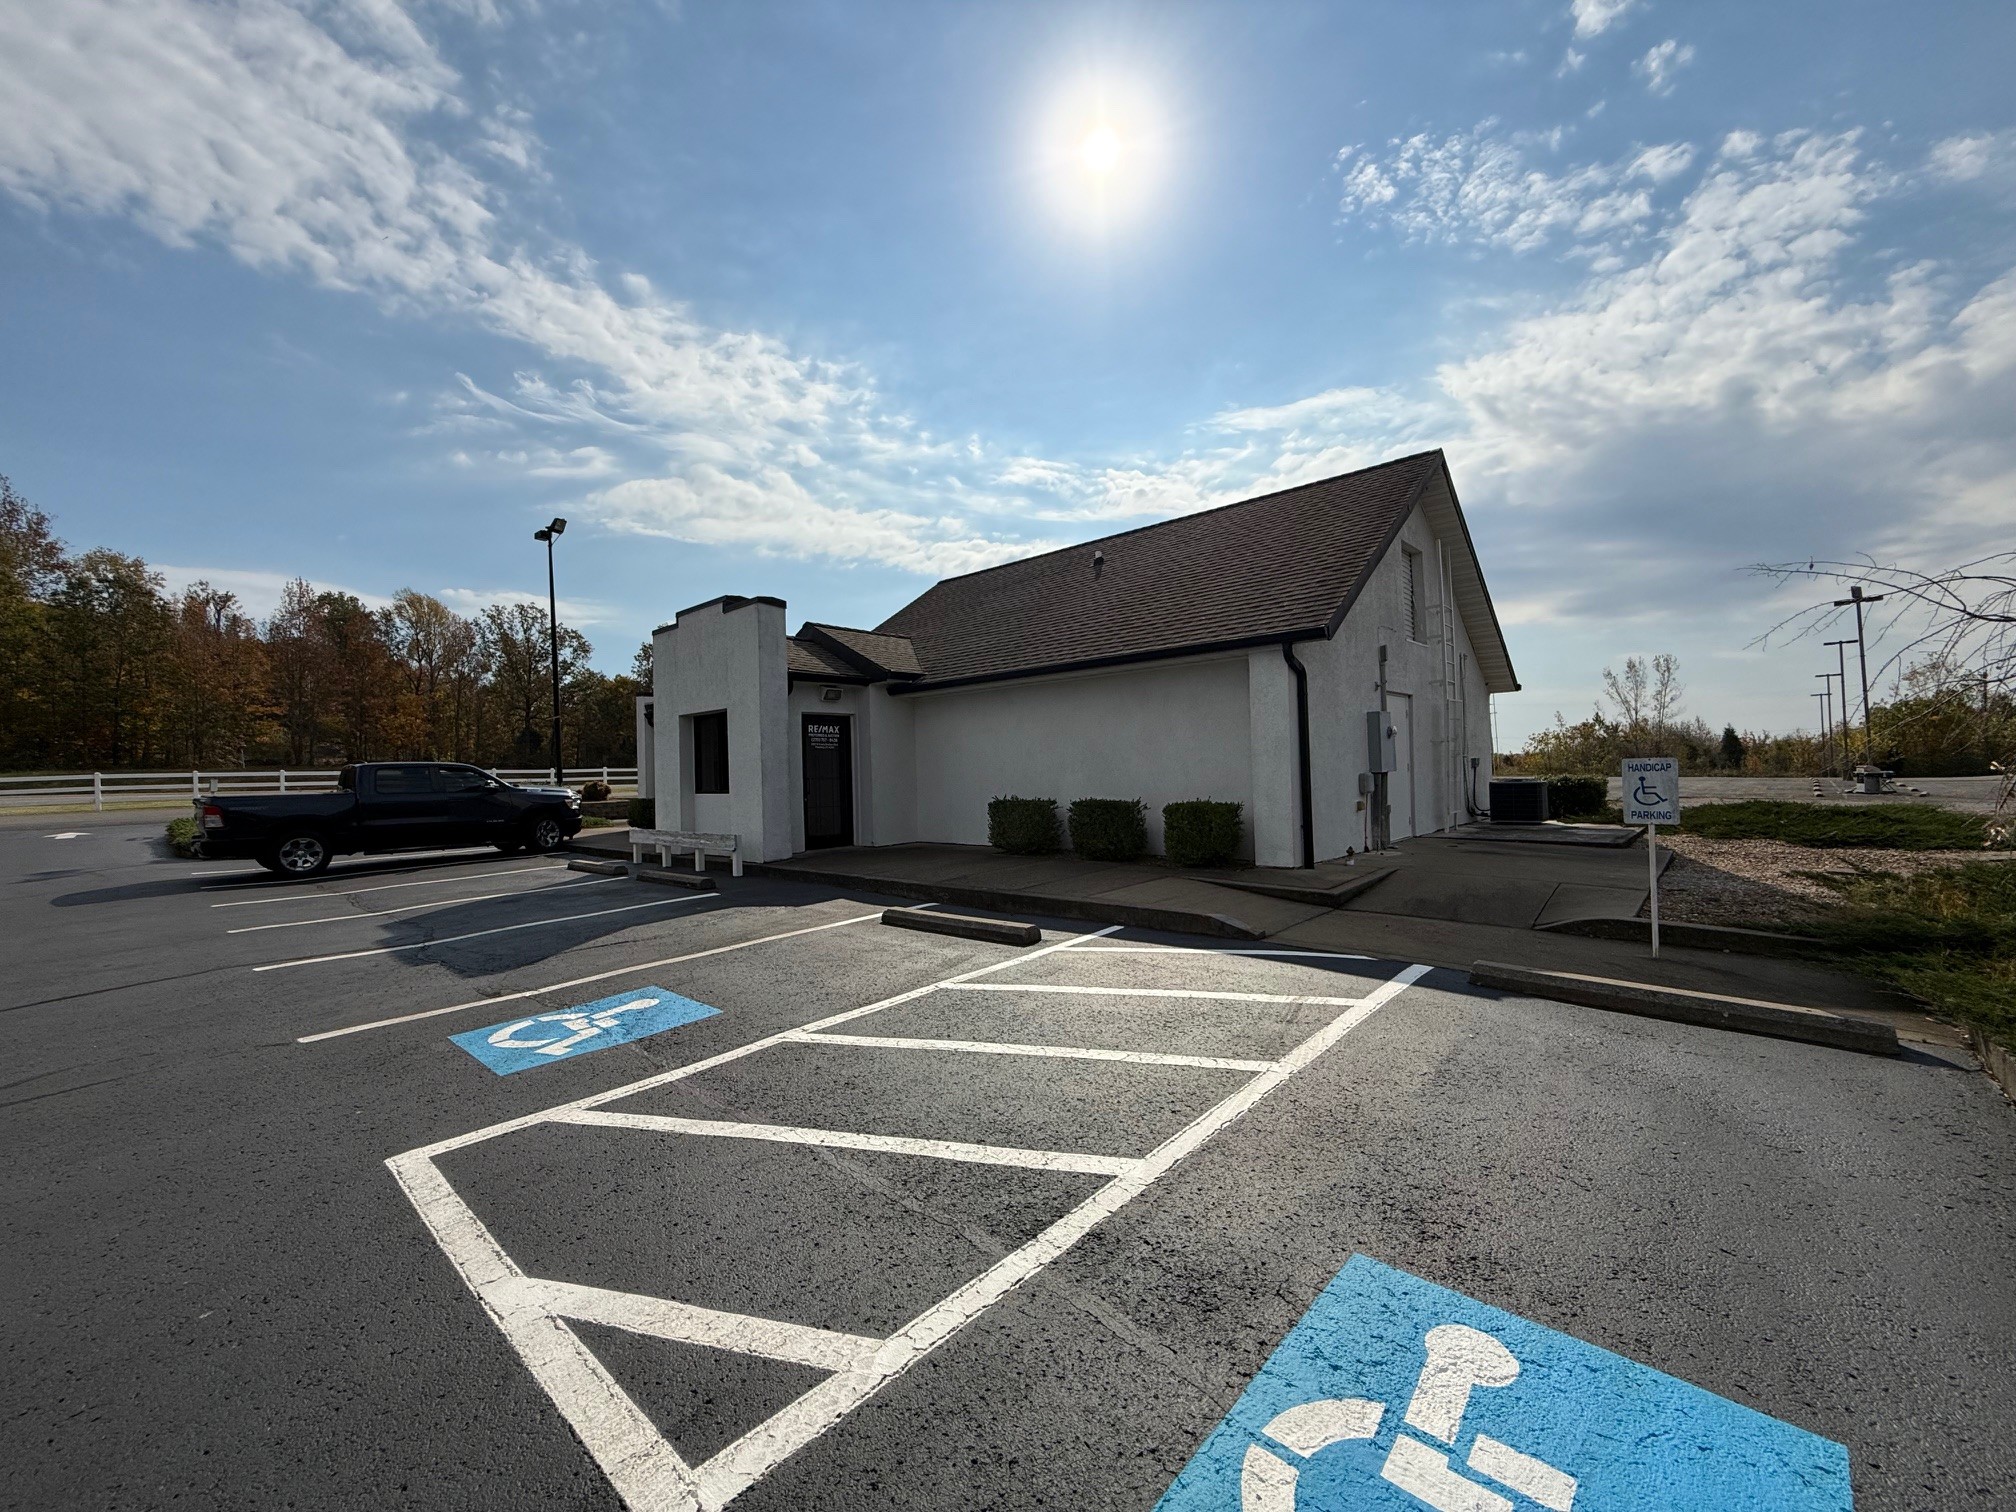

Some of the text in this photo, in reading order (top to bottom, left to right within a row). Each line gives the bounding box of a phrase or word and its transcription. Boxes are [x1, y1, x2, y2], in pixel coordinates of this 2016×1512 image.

[808, 724, 840, 734] RE/MAX
[1627, 763, 1672, 772] HANDICAP
[1631, 811, 1672, 820] PARKING
